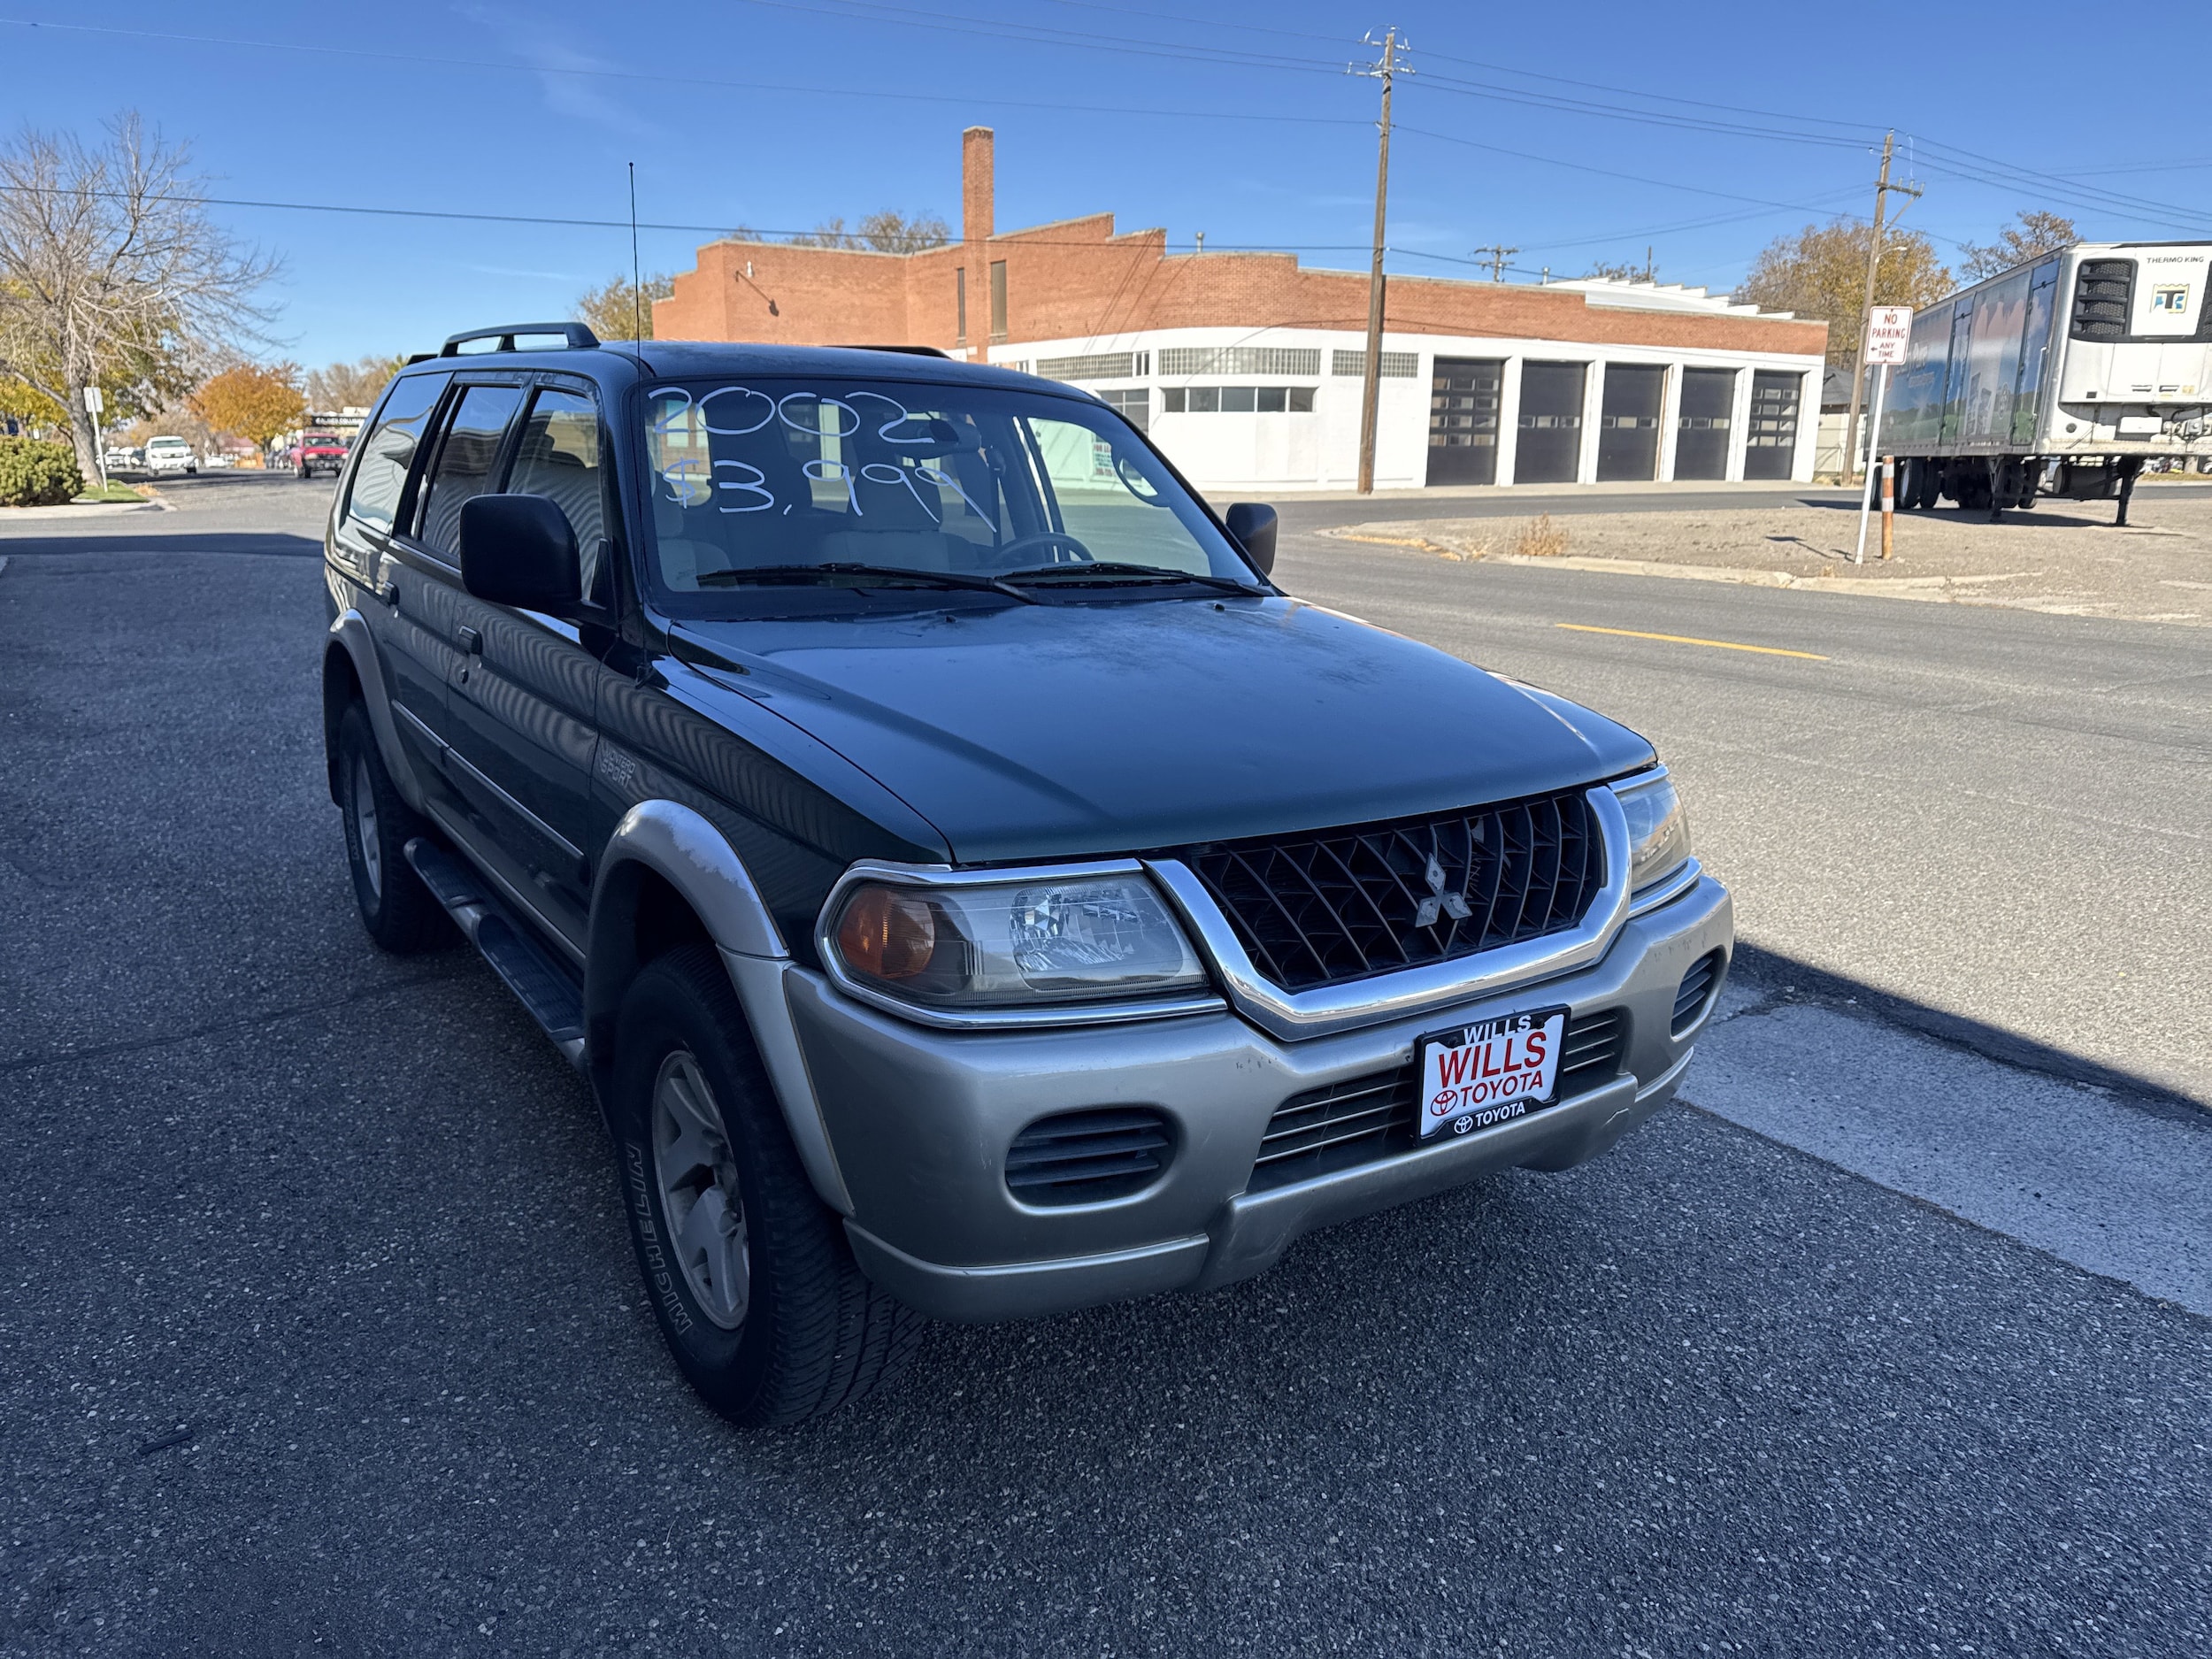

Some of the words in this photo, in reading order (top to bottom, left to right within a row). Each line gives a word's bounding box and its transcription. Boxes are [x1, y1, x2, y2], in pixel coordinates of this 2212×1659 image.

[1871, 328, 1906, 339] PARKING
[1884, 314, 1897, 325] NO
[649, 386, 935, 443] 2002
[663, 457, 997, 533] $3,999
[601, 758, 632, 788] SPORT
[1463, 1015, 1532, 1045] WILLS
[1438, 1032, 1547, 1088] WILLS
[1460, 1071, 1543, 1107] TOYOTA
[1475, 1102, 1525, 1127] TOYOTA
[625, 1143, 694, 1336] MICHELIN
